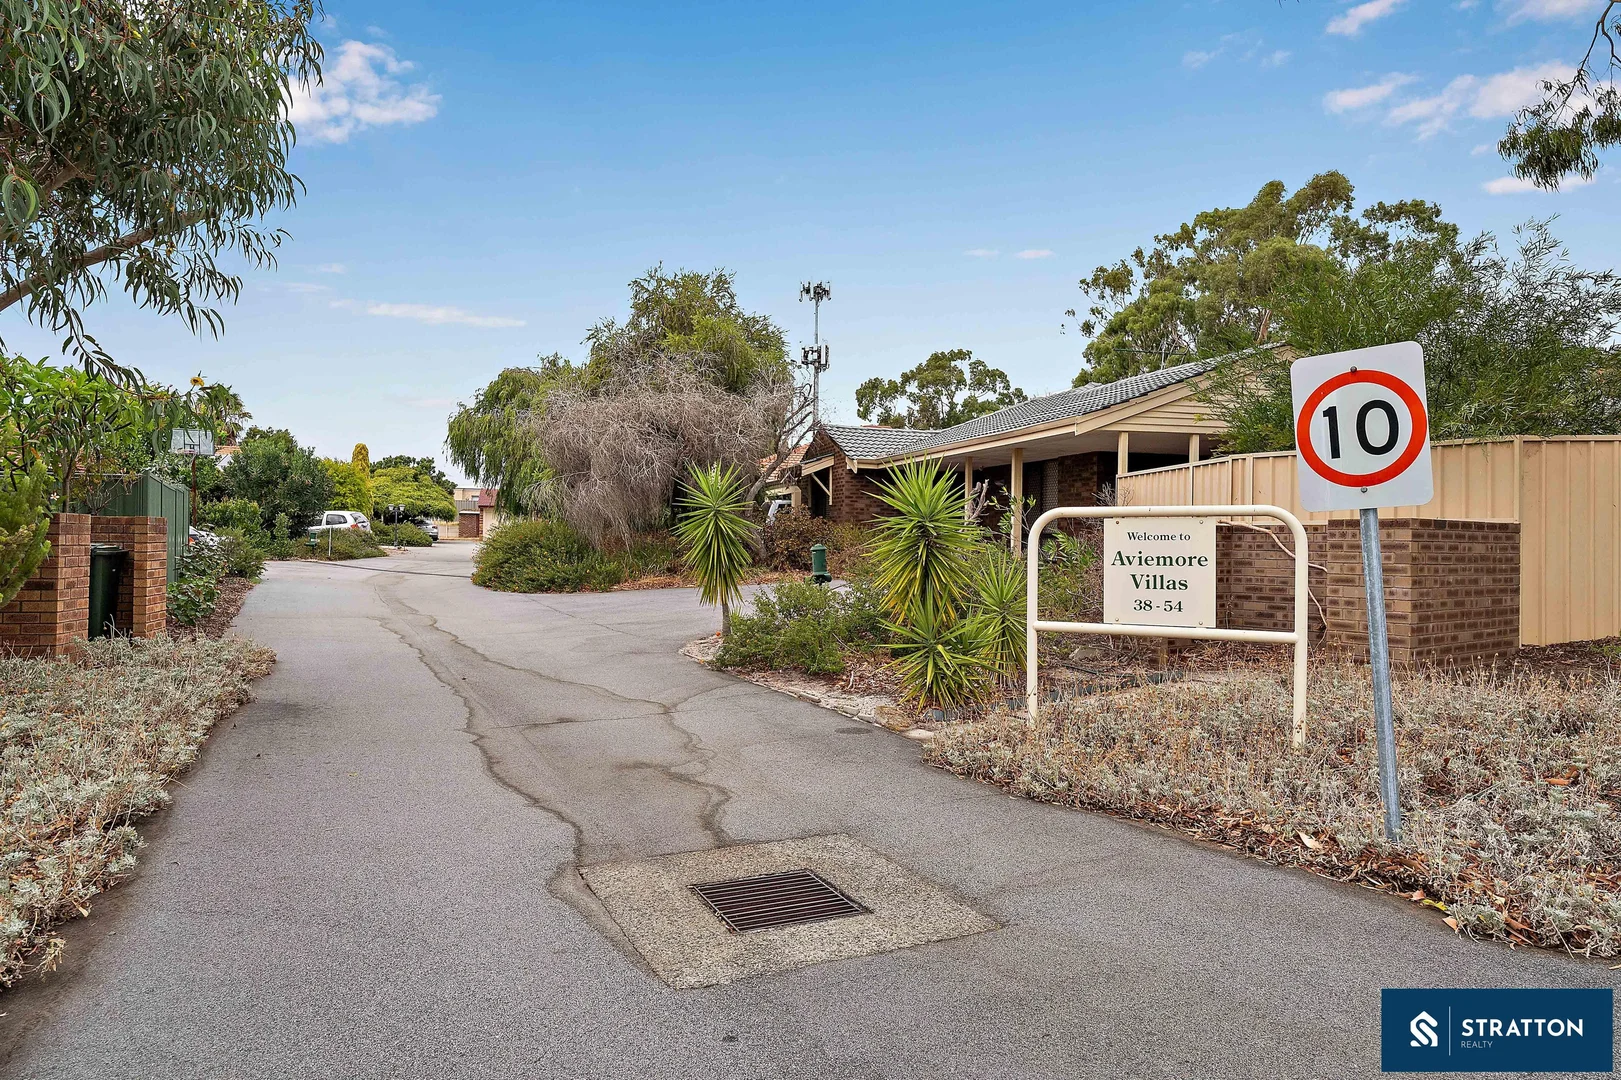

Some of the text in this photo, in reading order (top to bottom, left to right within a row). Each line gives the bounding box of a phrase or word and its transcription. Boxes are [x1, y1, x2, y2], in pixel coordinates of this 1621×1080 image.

[1322, 399, 1399, 460] 10
[1127, 532, 1191, 541] Welcome to
[1111, 550, 1209, 567] Aviemore
[1130, 574, 1188, 591] Villas
[1133, 599, 1153, 612] 38
[1163, 600, 1184, 613] 54
